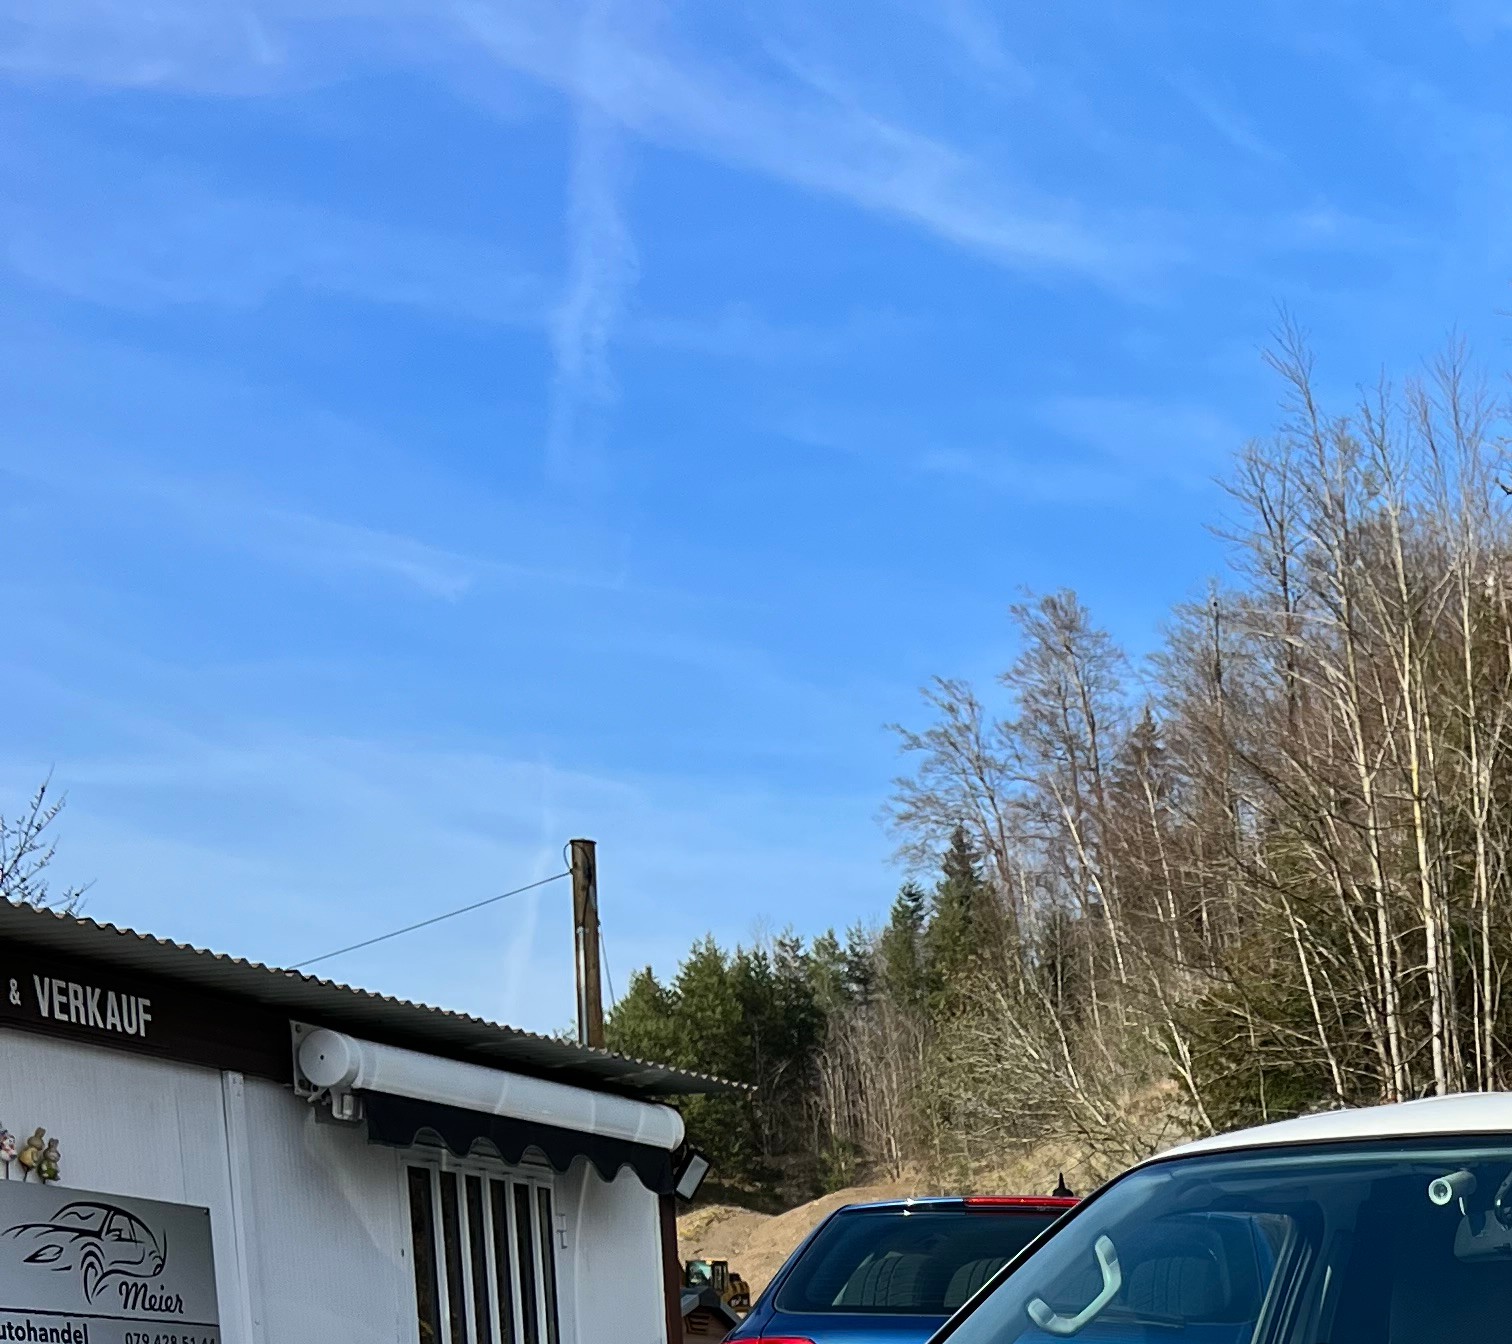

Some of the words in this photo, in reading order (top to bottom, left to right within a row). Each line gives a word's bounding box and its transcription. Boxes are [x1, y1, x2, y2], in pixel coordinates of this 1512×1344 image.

[9, 978, 21, 1006] &
[33, 974, 152, 1037] VERKAUF
[118, 1281, 184, 1315] Meier
[0, 1319, 89, 1344] utohandel
